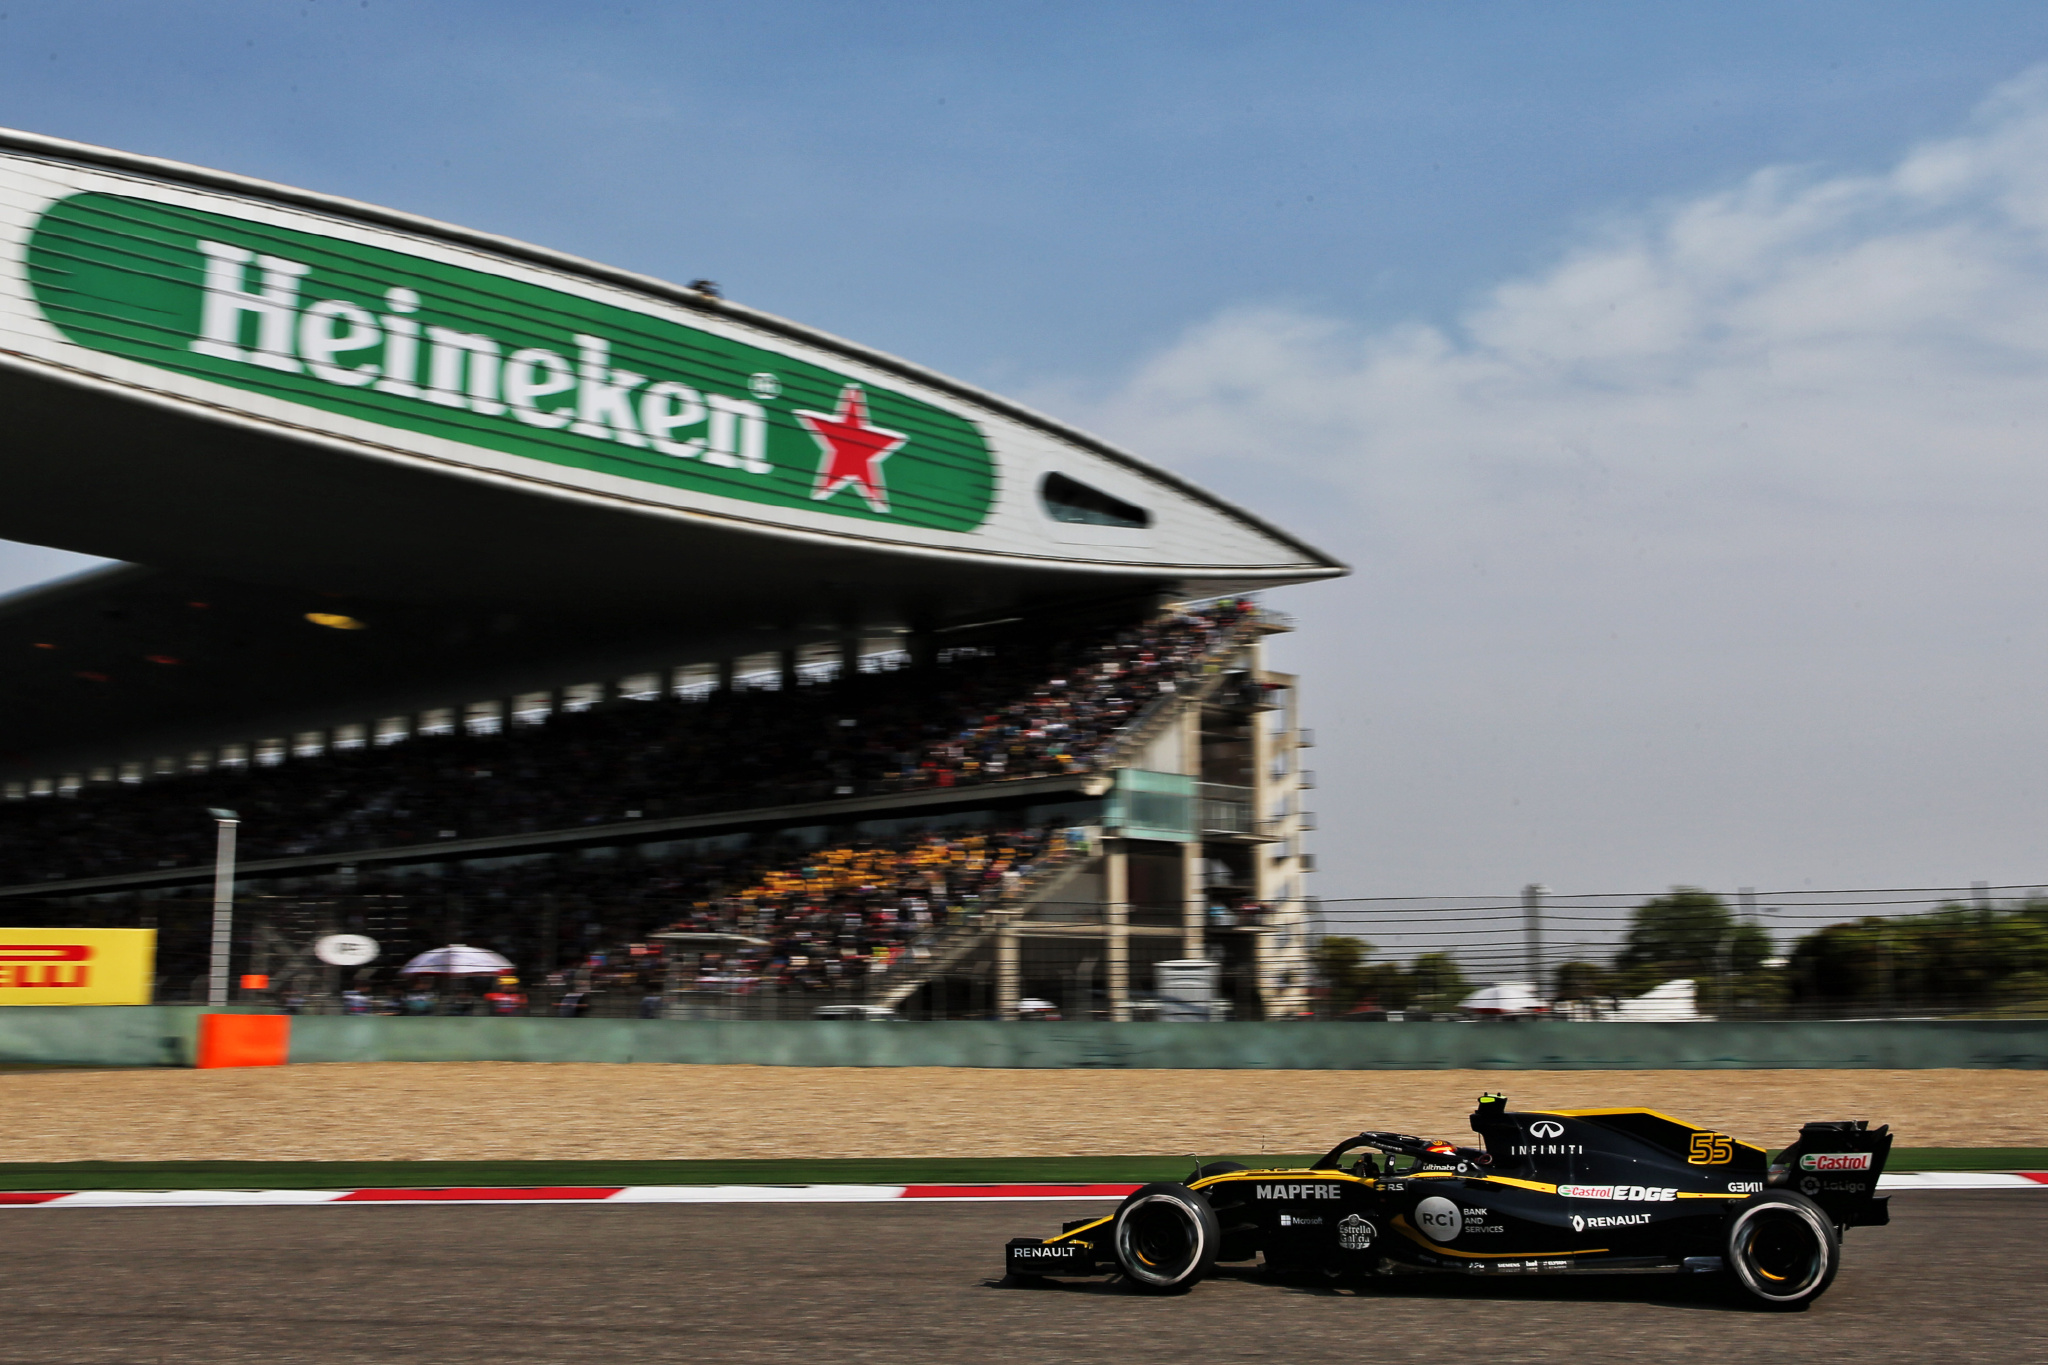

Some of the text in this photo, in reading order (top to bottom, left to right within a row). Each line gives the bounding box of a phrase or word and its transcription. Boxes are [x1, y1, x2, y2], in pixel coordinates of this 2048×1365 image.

[189, 240, 774, 475] Heineken
[1511, 1145, 1583, 1155] INFINITI
[1688, 1132, 1733, 1165] 55
[1817, 1155, 1867, 1170] Castrol
[1256, 1184, 1341, 1199] MAPFRE
[1572, 1186, 1678, 1201] Castrol EDGE
[1463, 1208, 1488, 1216] BANK
[1292, 1216, 1323, 1225] Microsoft
[1464, 1217, 1484, 1225] AND
[1587, 1213, 1652, 1228] RENAULT
[1339, 1224, 1371, 1234] Estrella
[1464, 1225, 1504, 1233] SERVICES
[1014, 1247, 1076, 1257] RENAULT
